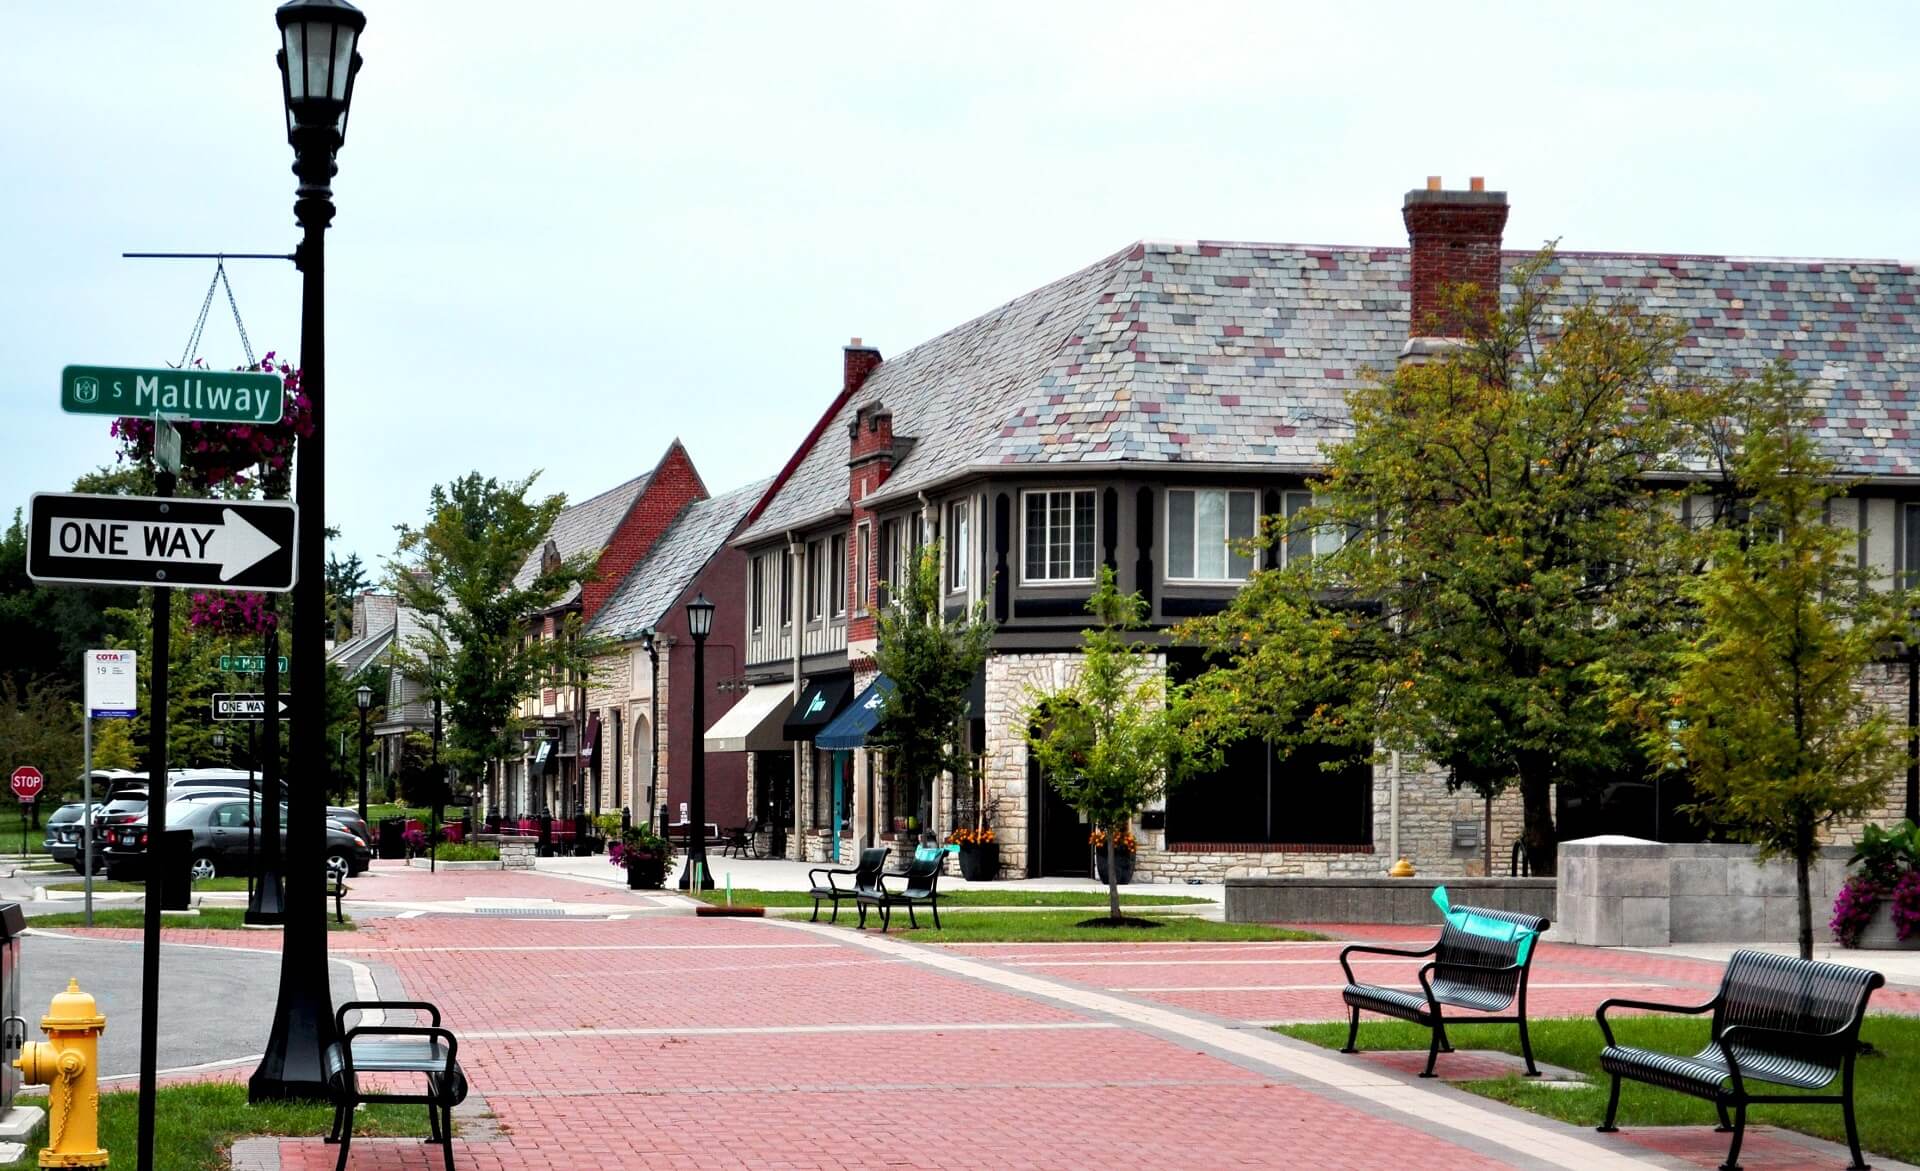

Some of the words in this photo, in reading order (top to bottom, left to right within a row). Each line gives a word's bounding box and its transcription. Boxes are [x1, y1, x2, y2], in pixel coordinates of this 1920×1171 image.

[112, 381, 122, 398] S
[135, 375, 270, 419] Mallway
[59, 522, 129, 556] ONE
[143, 525, 215, 559] WAY
[97, 667, 107, 675] 19
[221, 702, 243, 712] ONE
[13, 775, 41, 788] STOP
